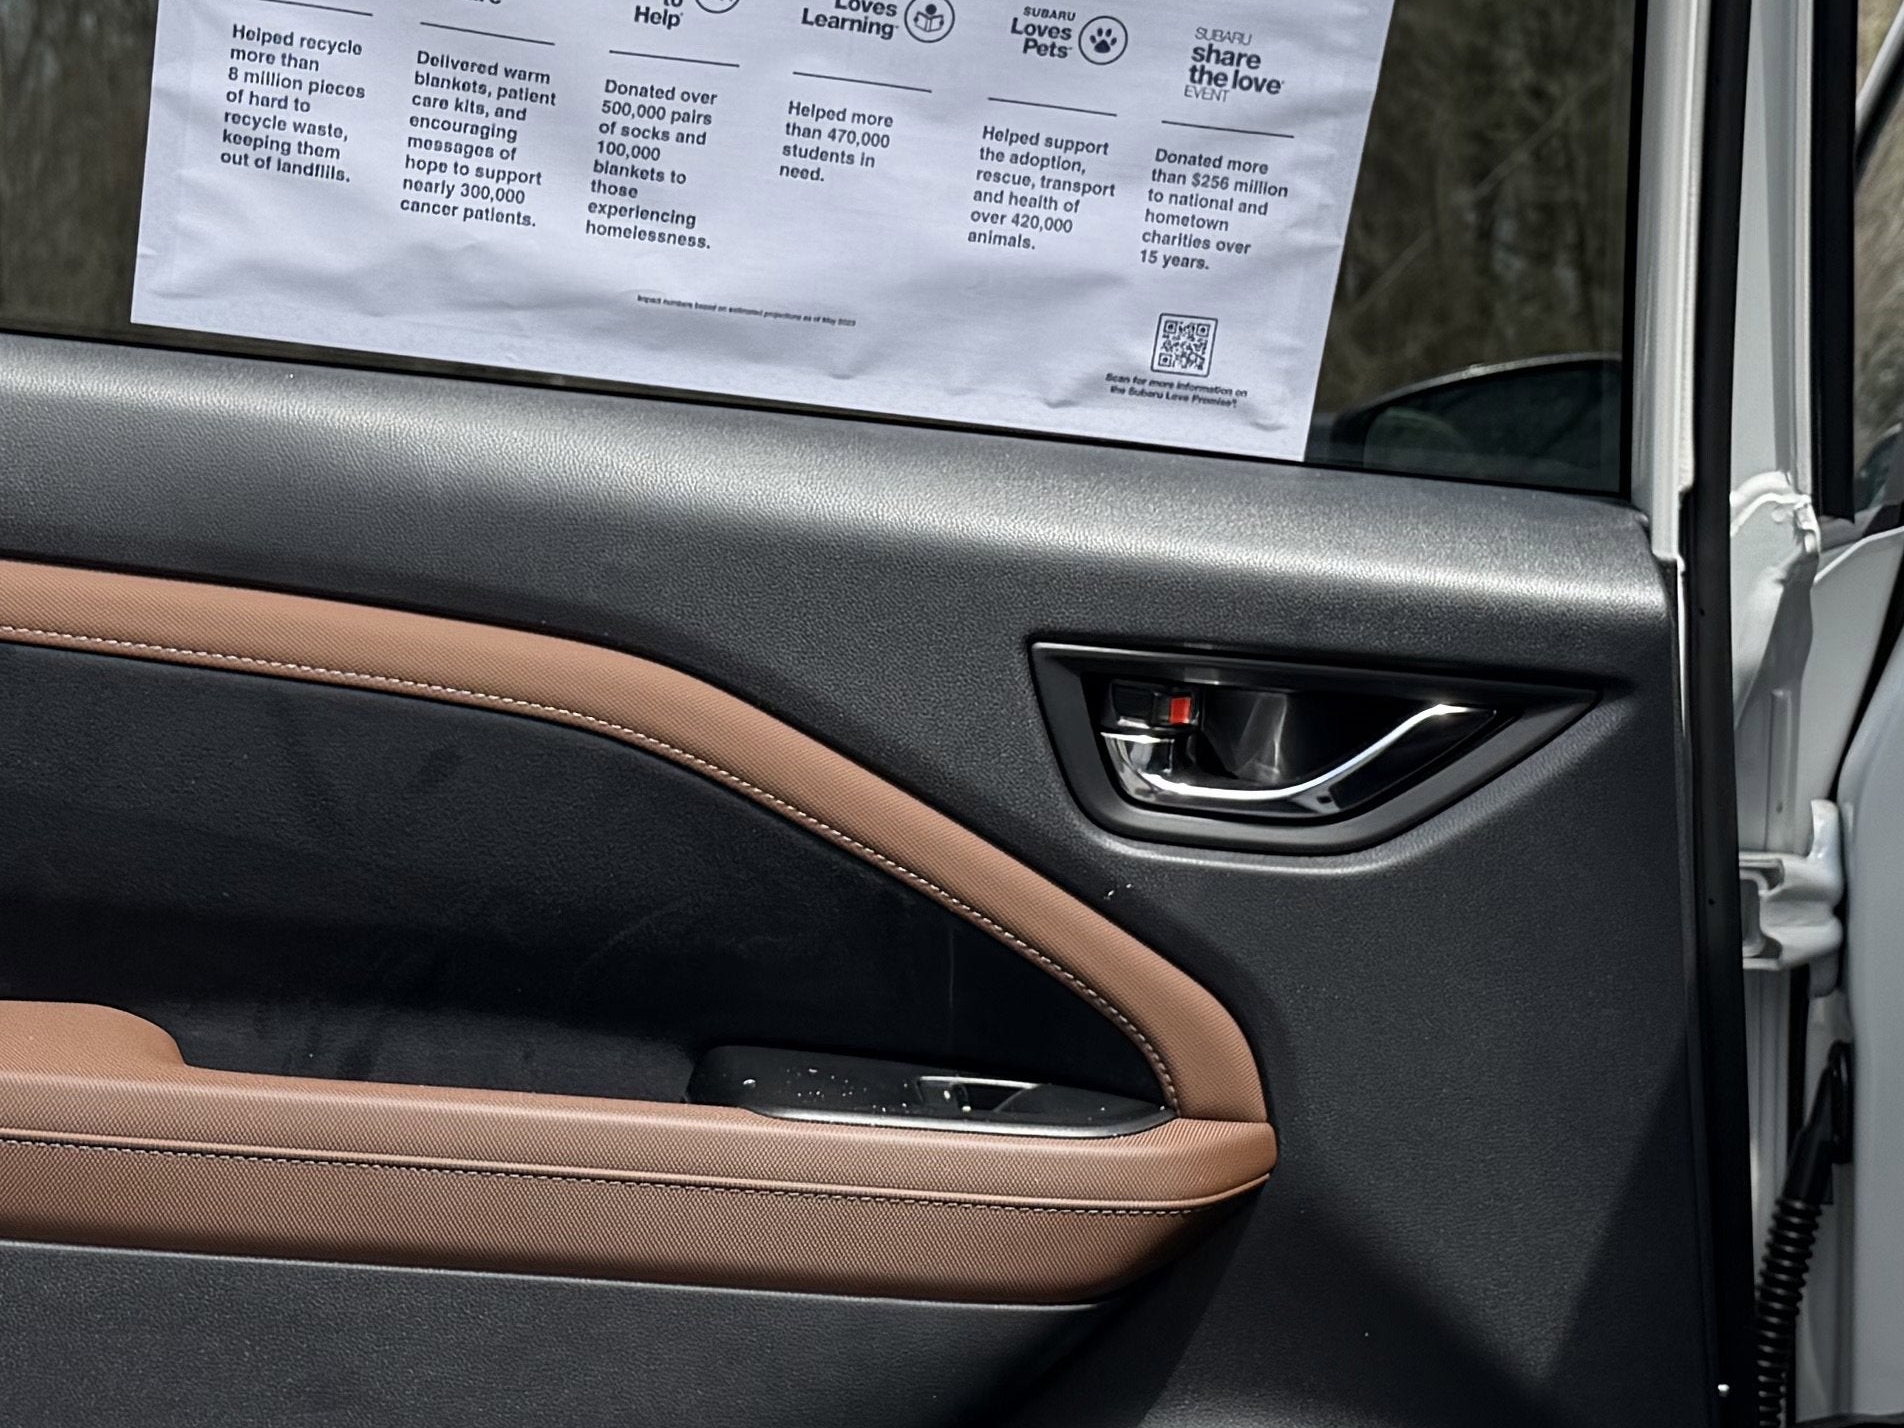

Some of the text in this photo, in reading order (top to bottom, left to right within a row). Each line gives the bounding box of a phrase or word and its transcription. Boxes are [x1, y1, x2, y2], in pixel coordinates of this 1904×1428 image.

[634, 6, 683, 29] Help
[801, 10, 897, 40] Learning
[1023, 6, 1076, 22] SUBARU
[232, 24, 362, 55] Helped recycle
[1010, 16, 1072, 41] Loves
[1194, 26, 1253, 46] SUBARU
[230, 48, 319, 72] more than
[1022, 38, 1071, 59] Pets
[1191, 45, 1262, 70] share
[417, 50, 550, 85] Delivered warm
[1187, 65, 1284, 95] the love
[228, 66, 365, 99] 8 million pieces
[414, 70, 556, 107] blankets, patient
[604, 78, 718, 105] Donated over
[1184, 85, 1232, 103] EVENT
[226, 89, 311, 113] of hard to
[412, 94, 527, 121] care kits, and
[601, 99, 712, 126] 500,000 pairs
[788, 100, 894, 128] Helped more
[224, 111, 348, 142] recycle waste,
[409, 115, 518, 144] encouraging
[598, 121, 707, 145] of socks and
[785, 122, 890, 149] than 470,000
[222, 129, 340, 160] keeping them
[407, 136, 517, 161] messages of
[597, 140, 661, 162] 100,000
[982, 125, 1109, 156] Helped support
[220, 152, 350, 183] out of landfills.
[782, 143, 875, 168] students in
[979, 146, 1086, 175] the adoption,
[1155, 148, 1269, 175] Donated more
[405, 154, 542, 186] hope to support
[593, 159, 687, 185] blankets to
[779, 165, 824, 182] need.
[976, 169, 1115, 197] rescue, transport
[1151, 168, 1288, 198] than $256 million
[403, 178, 525, 205] nearly 300,000
[590, 179, 638, 199] those
[973, 190, 1080, 214] and health of
[1148, 188, 1269, 216] to national and
[400, 199, 536, 227] cancer patients.
[588, 201, 696, 230] experiencing
[970, 210, 1073, 233] over 420,000
[1144, 208, 1229, 232] hometown
[585, 220, 711, 249] homelessness.
[967, 231, 1035, 250] animals.
[1142, 230, 1252, 255] charities over
[1140, 249, 1210, 270] 15 years.
[1105, 373, 1248, 398] Scan for more information on
[1110, 385, 1126, 395] the
[1128, 387, 1164, 400] Subaru
[1165, 391, 1189, 402] Love
